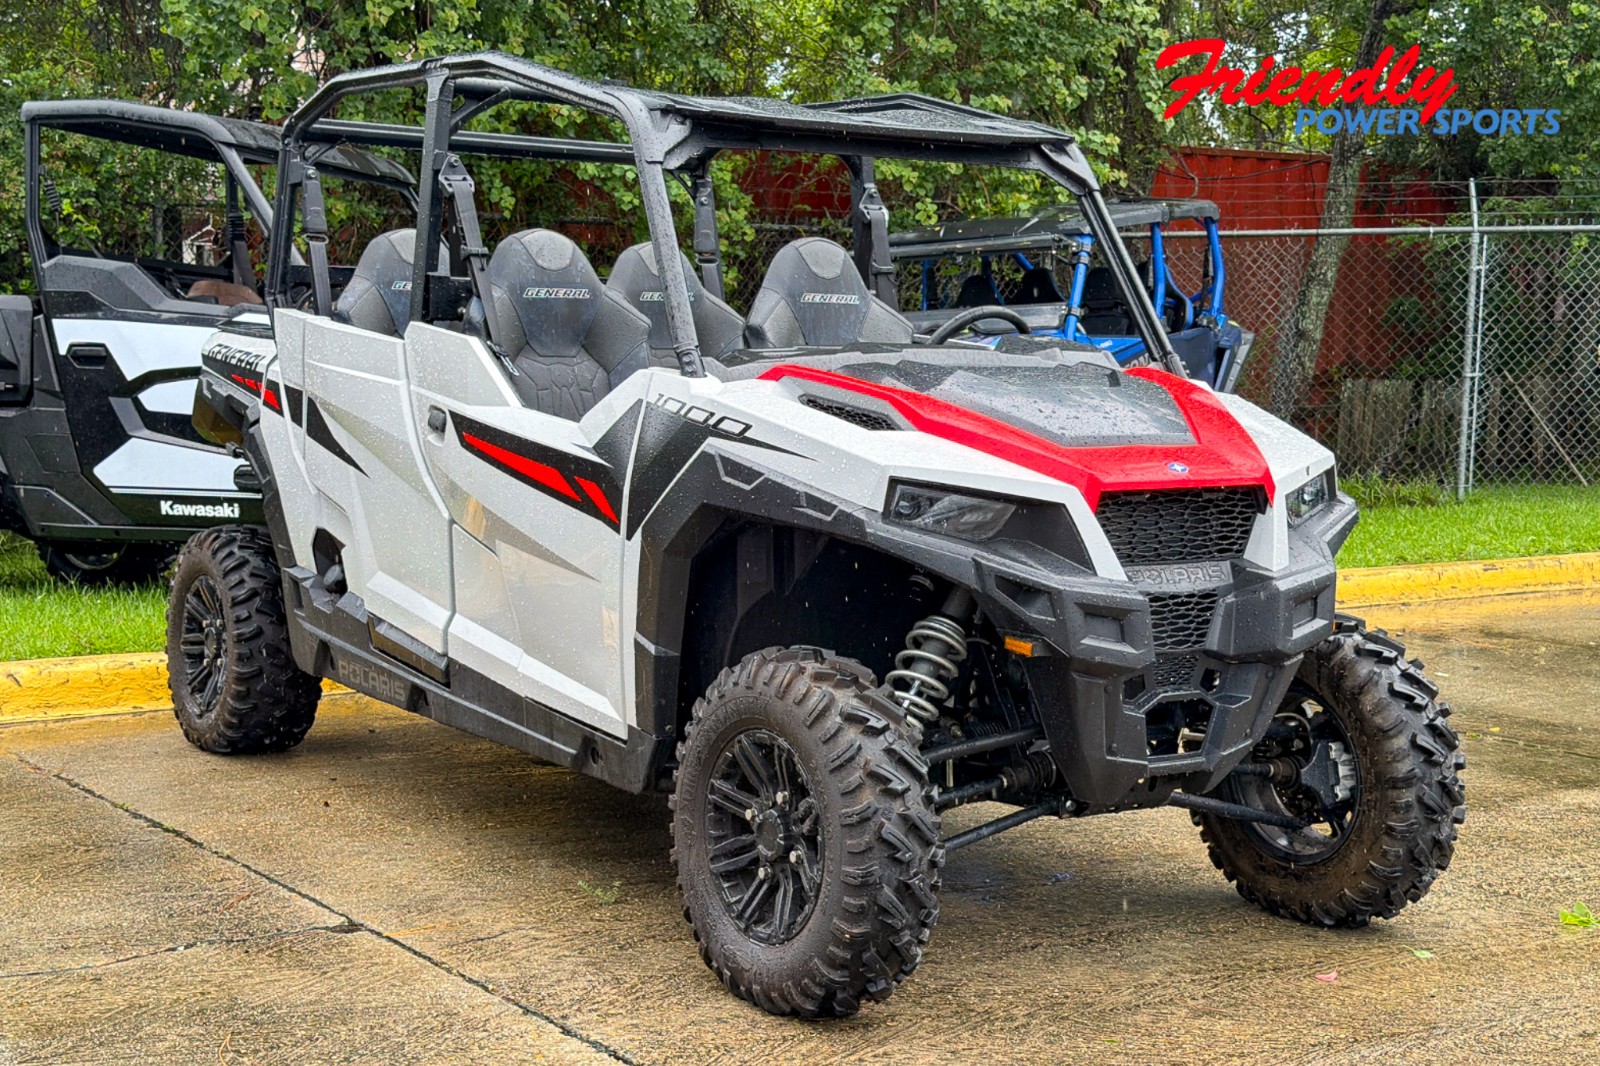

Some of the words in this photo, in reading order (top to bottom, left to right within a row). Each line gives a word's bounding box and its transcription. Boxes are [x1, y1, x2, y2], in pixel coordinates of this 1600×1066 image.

[523, 287, 590, 299] GENERAL
[800, 292, 860, 304] GENERAL
[655, 393, 753, 438] 1000
[160, 500, 240, 518] Kawasaki
[1126, 564, 1226, 584] POLARIS
[337, 659, 406, 702] POLARIS
